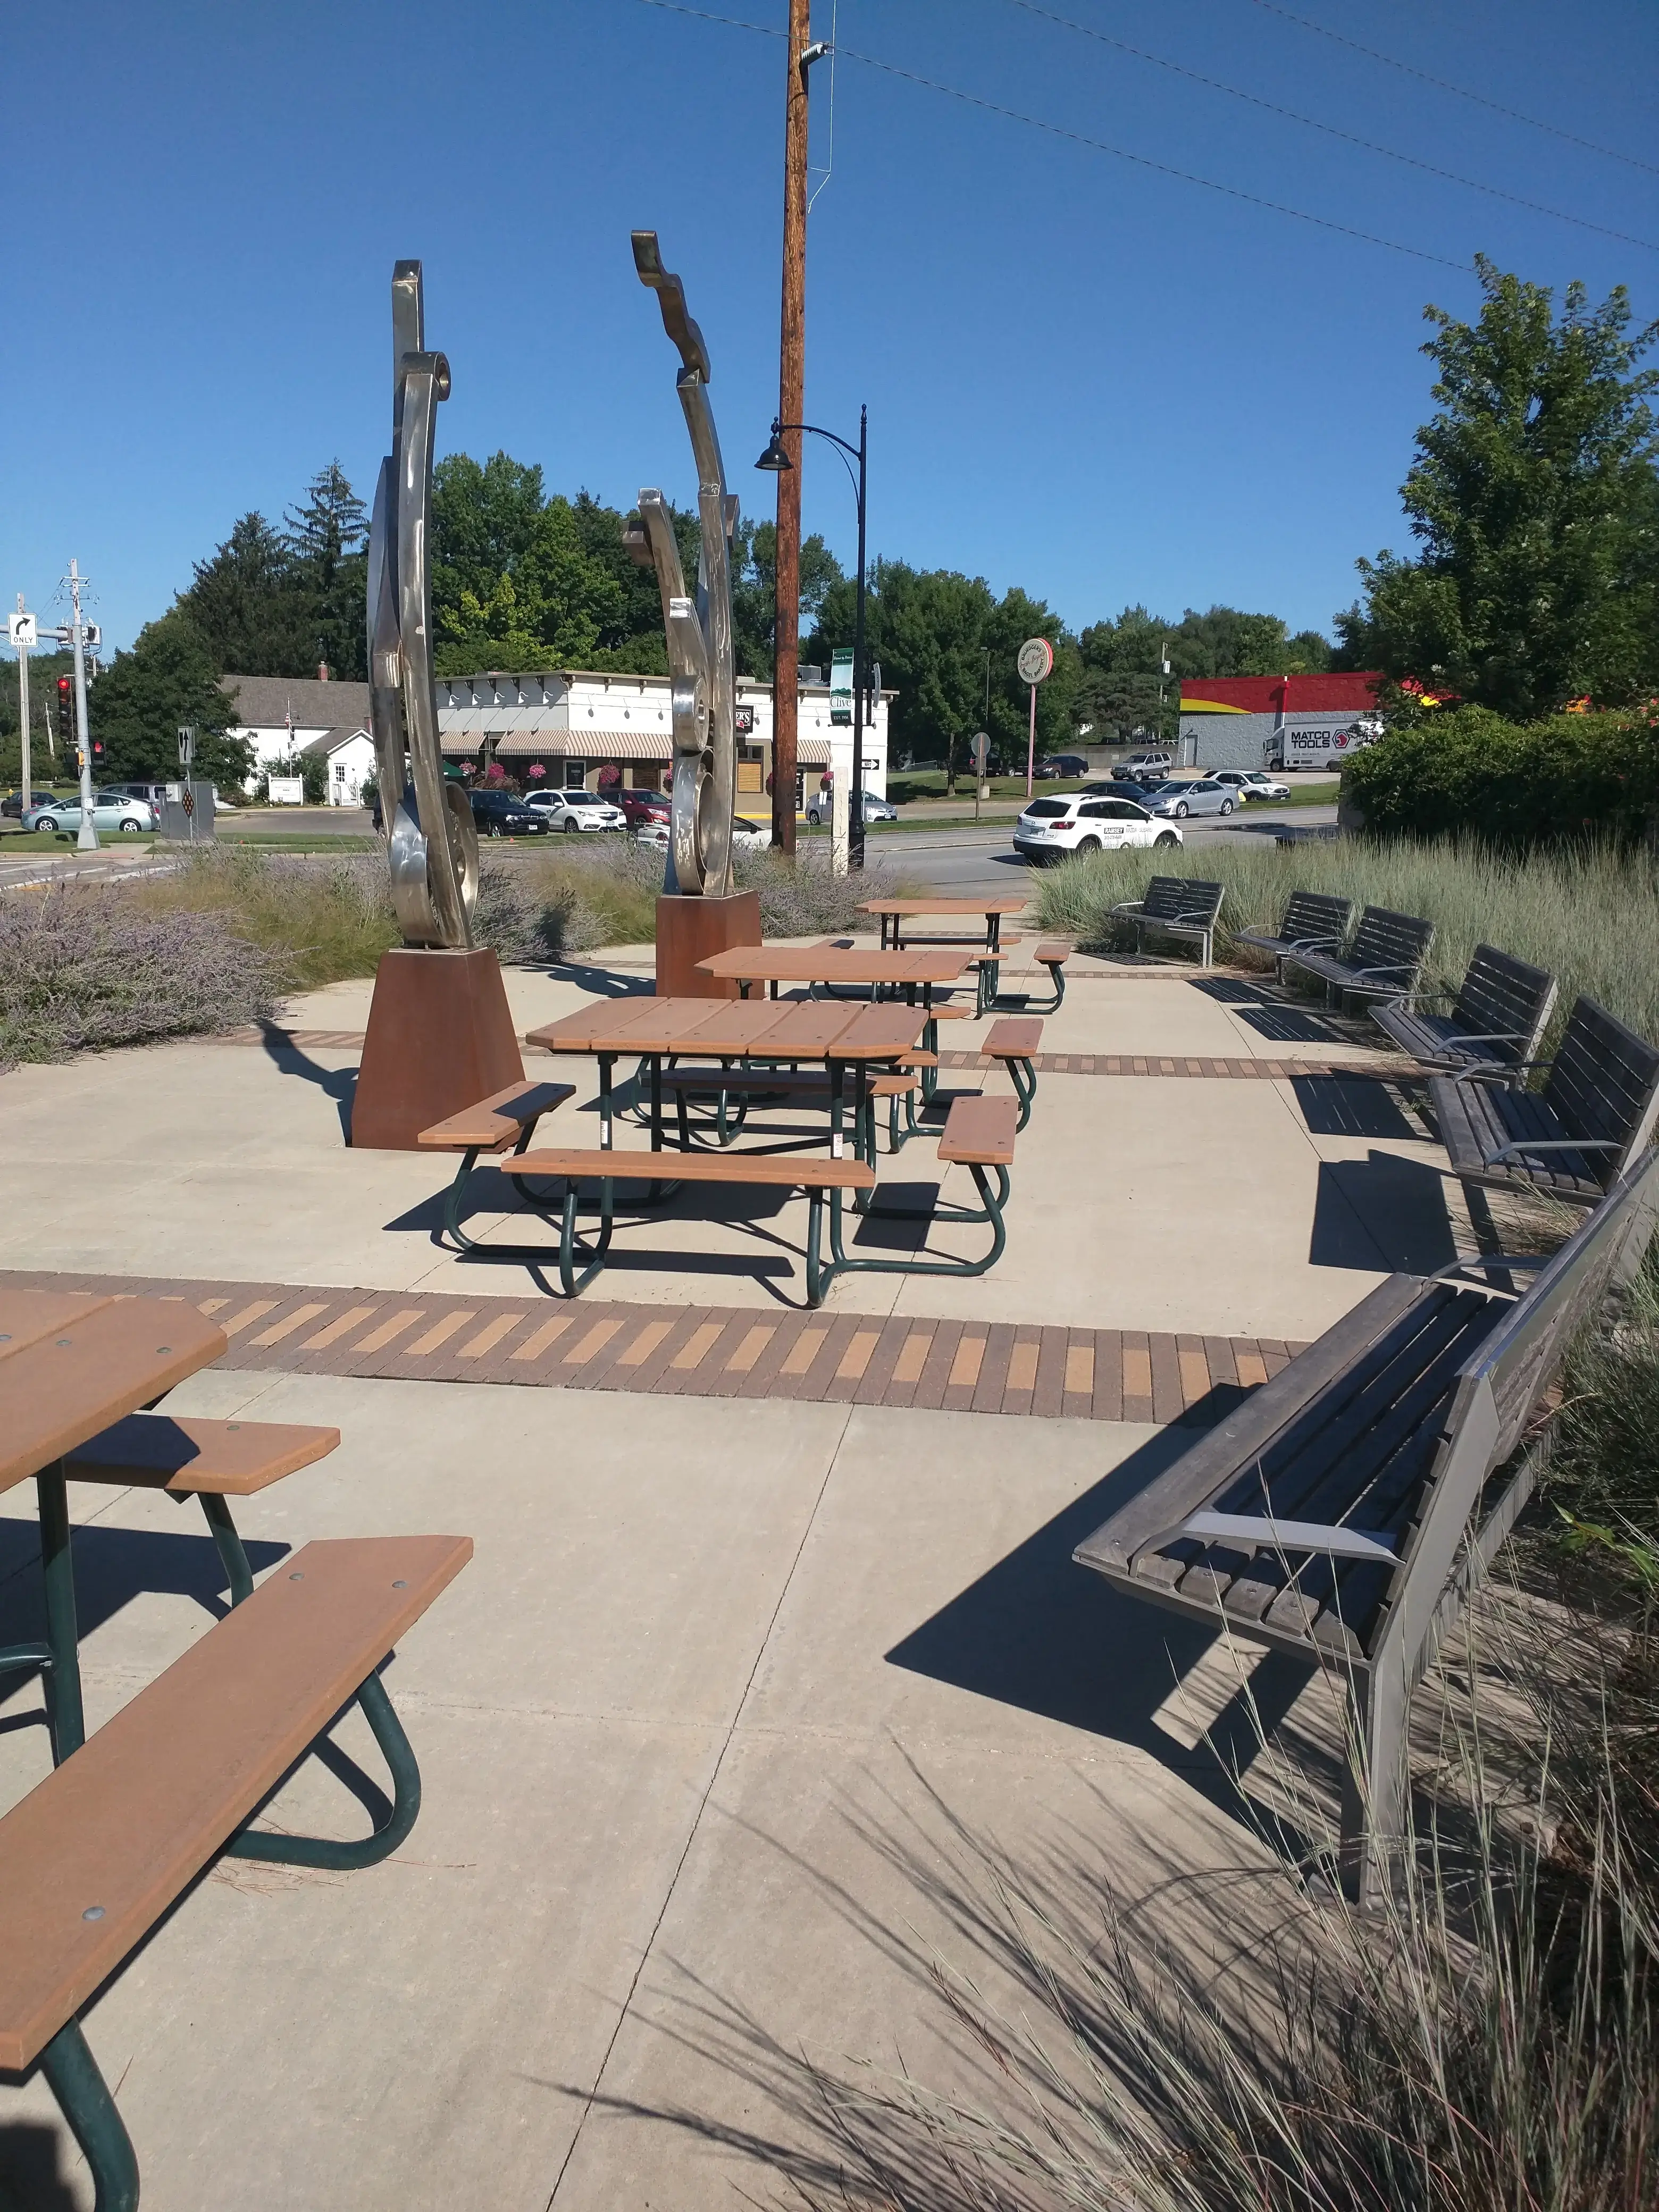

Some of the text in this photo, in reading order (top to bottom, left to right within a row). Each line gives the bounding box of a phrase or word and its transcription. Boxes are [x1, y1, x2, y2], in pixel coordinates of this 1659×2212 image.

[1022, 658, 1044, 677] BAGEL BAKERY
[830, 697, 852, 707] Clive
[1291, 731, 1330, 740] MATCO
[1291, 740, 1330, 749] TOOLS
